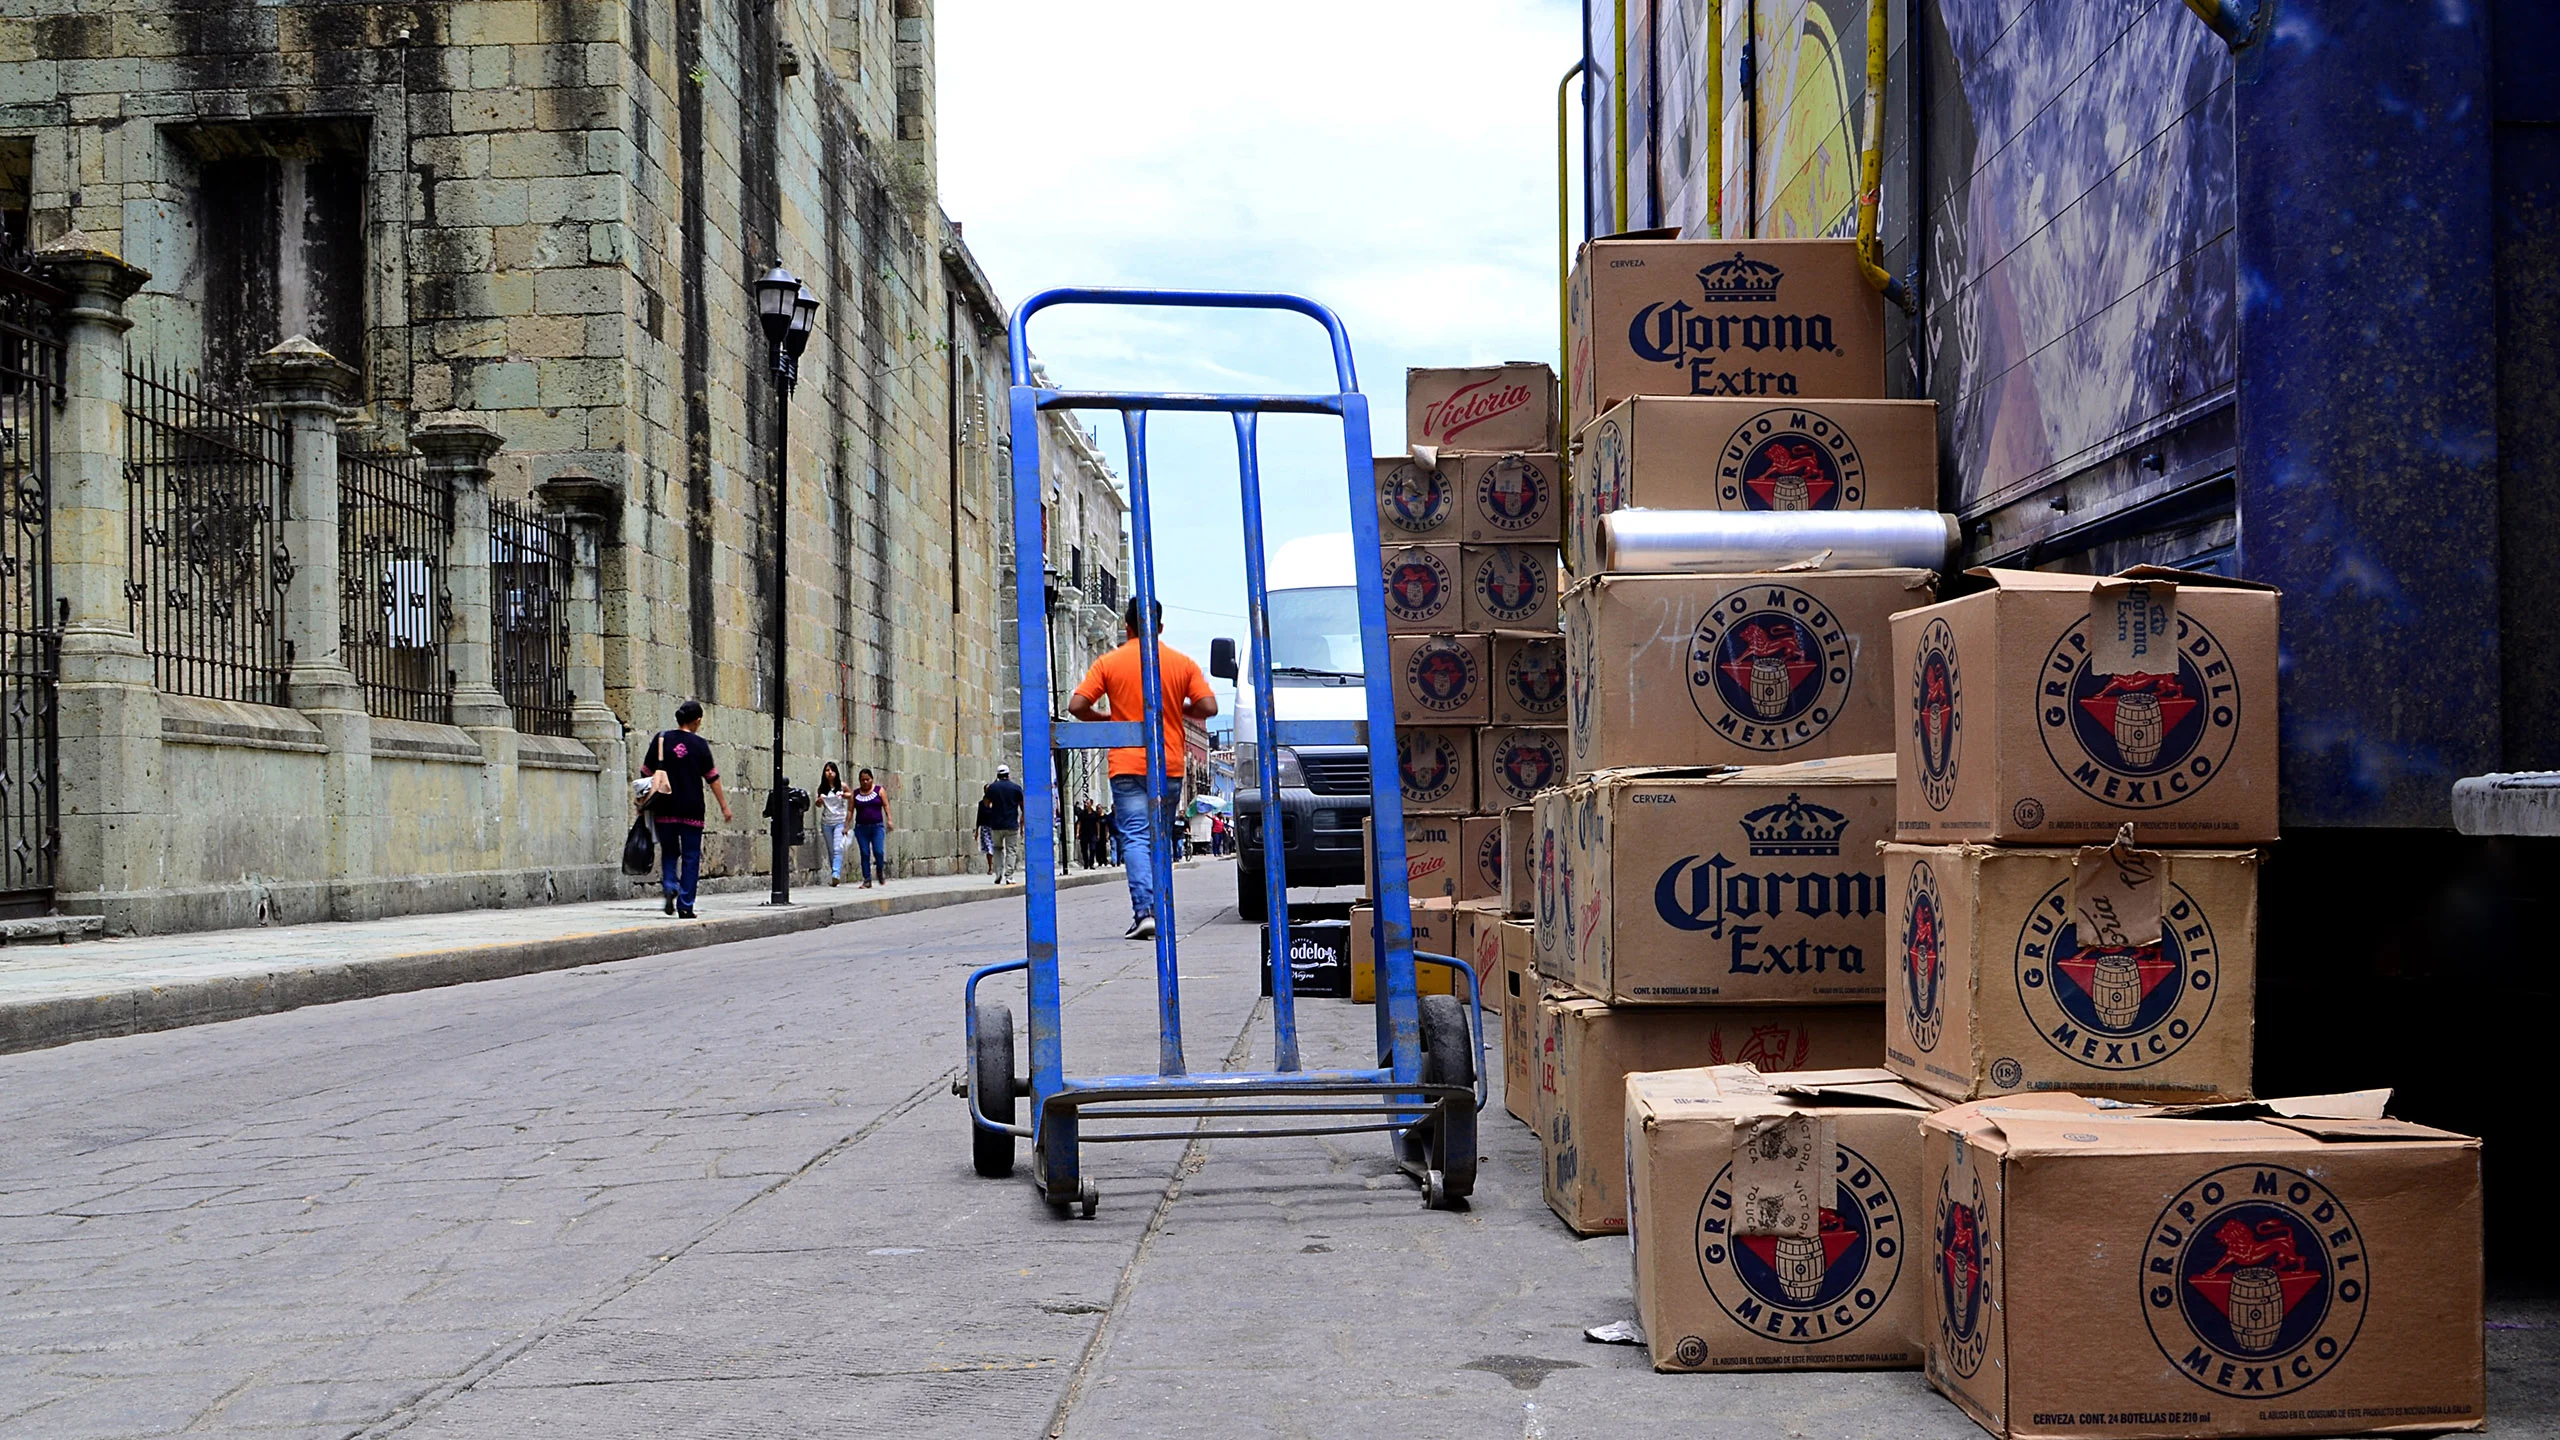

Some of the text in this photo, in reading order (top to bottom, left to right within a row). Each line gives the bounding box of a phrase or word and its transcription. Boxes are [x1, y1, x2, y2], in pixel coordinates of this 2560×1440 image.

[1610, 259, 1645, 268] CERVEZA
[1629, 300, 1838, 369] Corona
[1689, 357, 1798, 396] Extra
[1423, 374, 1531, 445] Victoria
[1722, 412, 1862, 502] GRUPO MODELO
[1384, 472, 1451, 505] GRUP DELO
[1480, 465, 1547, 503] GRUP ODELO
[1395, 514, 1443, 530] MEXICO
[1490, 512, 1539, 528] MEXICO
[1383, 556, 1449, 594] GRUP ODELO
[1478, 555, 1545, 594] GRUP ODELO
[1393, 602, 1441, 619] MEXICO
[1488, 603, 1536, 619] MEXICO
[1693, 597, 1747, 687] GRUPO
[1767, 589, 1846, 686] MODELO
[1453, 645, 1475, 683] ODELO
[1934, 624, 1960, 732] MODELO
[2046, 619, 2233, 727] GRUP ODELO
[1420, 693, 1468, 709] MEXICO
[1519, 695, 1567, 711] MEXICO
[1716, 707, 1829, 746] MEXICO
[1442, 743, 1457, 774] DELO
[1541, 735, 1562, 773] ODELO
[1401, 784, 1449, 800] MEXICO
[1632, 794, 1676, 804] CERVEZA
[1922, 761, 1955, 804] MEXICO
[2073, 756, 2211, 803] MEXICO
[1922, 866, 1945, 982] MODELO
[2024, 896, 2211, 991] GRUP DELO
[1290, 943, 1325, 959] odelo
[1728, 925, 1866, 975] Extra
[1633, 987, 1650, 995] CONT.
[1661, 987, 1689, 995] BOTELLAS
[1690, 987, 1697, 995] DE
[1908, 1007, 1940, 1050] MEXICO
[2051, 1018, 2189, 1064] MEXICO
[1795, 1120, 1811, 1172] ICTORIA
[1604, 1217, 1625, 1225] CONT.
[1705, 1151, 1896, 1264] GRU ODELO
[1746, 1186, 1759, 1233] TOLUCA
[1936, 1177, 1990, 1305] GRUP ODELO
[2151, 1171, 2362, 1308] GRUPO MODELO
[1736, 1287, 1876, 1336] MEXICO
[1712, 1358, 1719, 1366] EL
[1740, 1357, 1747, 1365] EN
[1748, 1357, 1754, 1365] EL
[1755, 1356, 1783, 1364] CONSUMO
[1784, 1356, 1791, 1364] DE
[1792, 1355, 1805, 1363] ESTE
[1806, 1355, 1835, 1363] PRODUCTO
[1837, 1355, 1843, 1363] ES
[1942, 1318, 1983, 1371] MEXICO
[2182, 1335, 2338, 1391] MEXICO
[2033, 1412, 2211, 1425] CERVEZA CONT. 24 BOTELLAS DE 210 ml
[2260, 1411, 2267, 1420] EL
[2290, 1410, 2298, 1419] EN
[2299, 1410, 2306, 1419] EL
[2307, 1409, 2337, 1418] CONSUMO
